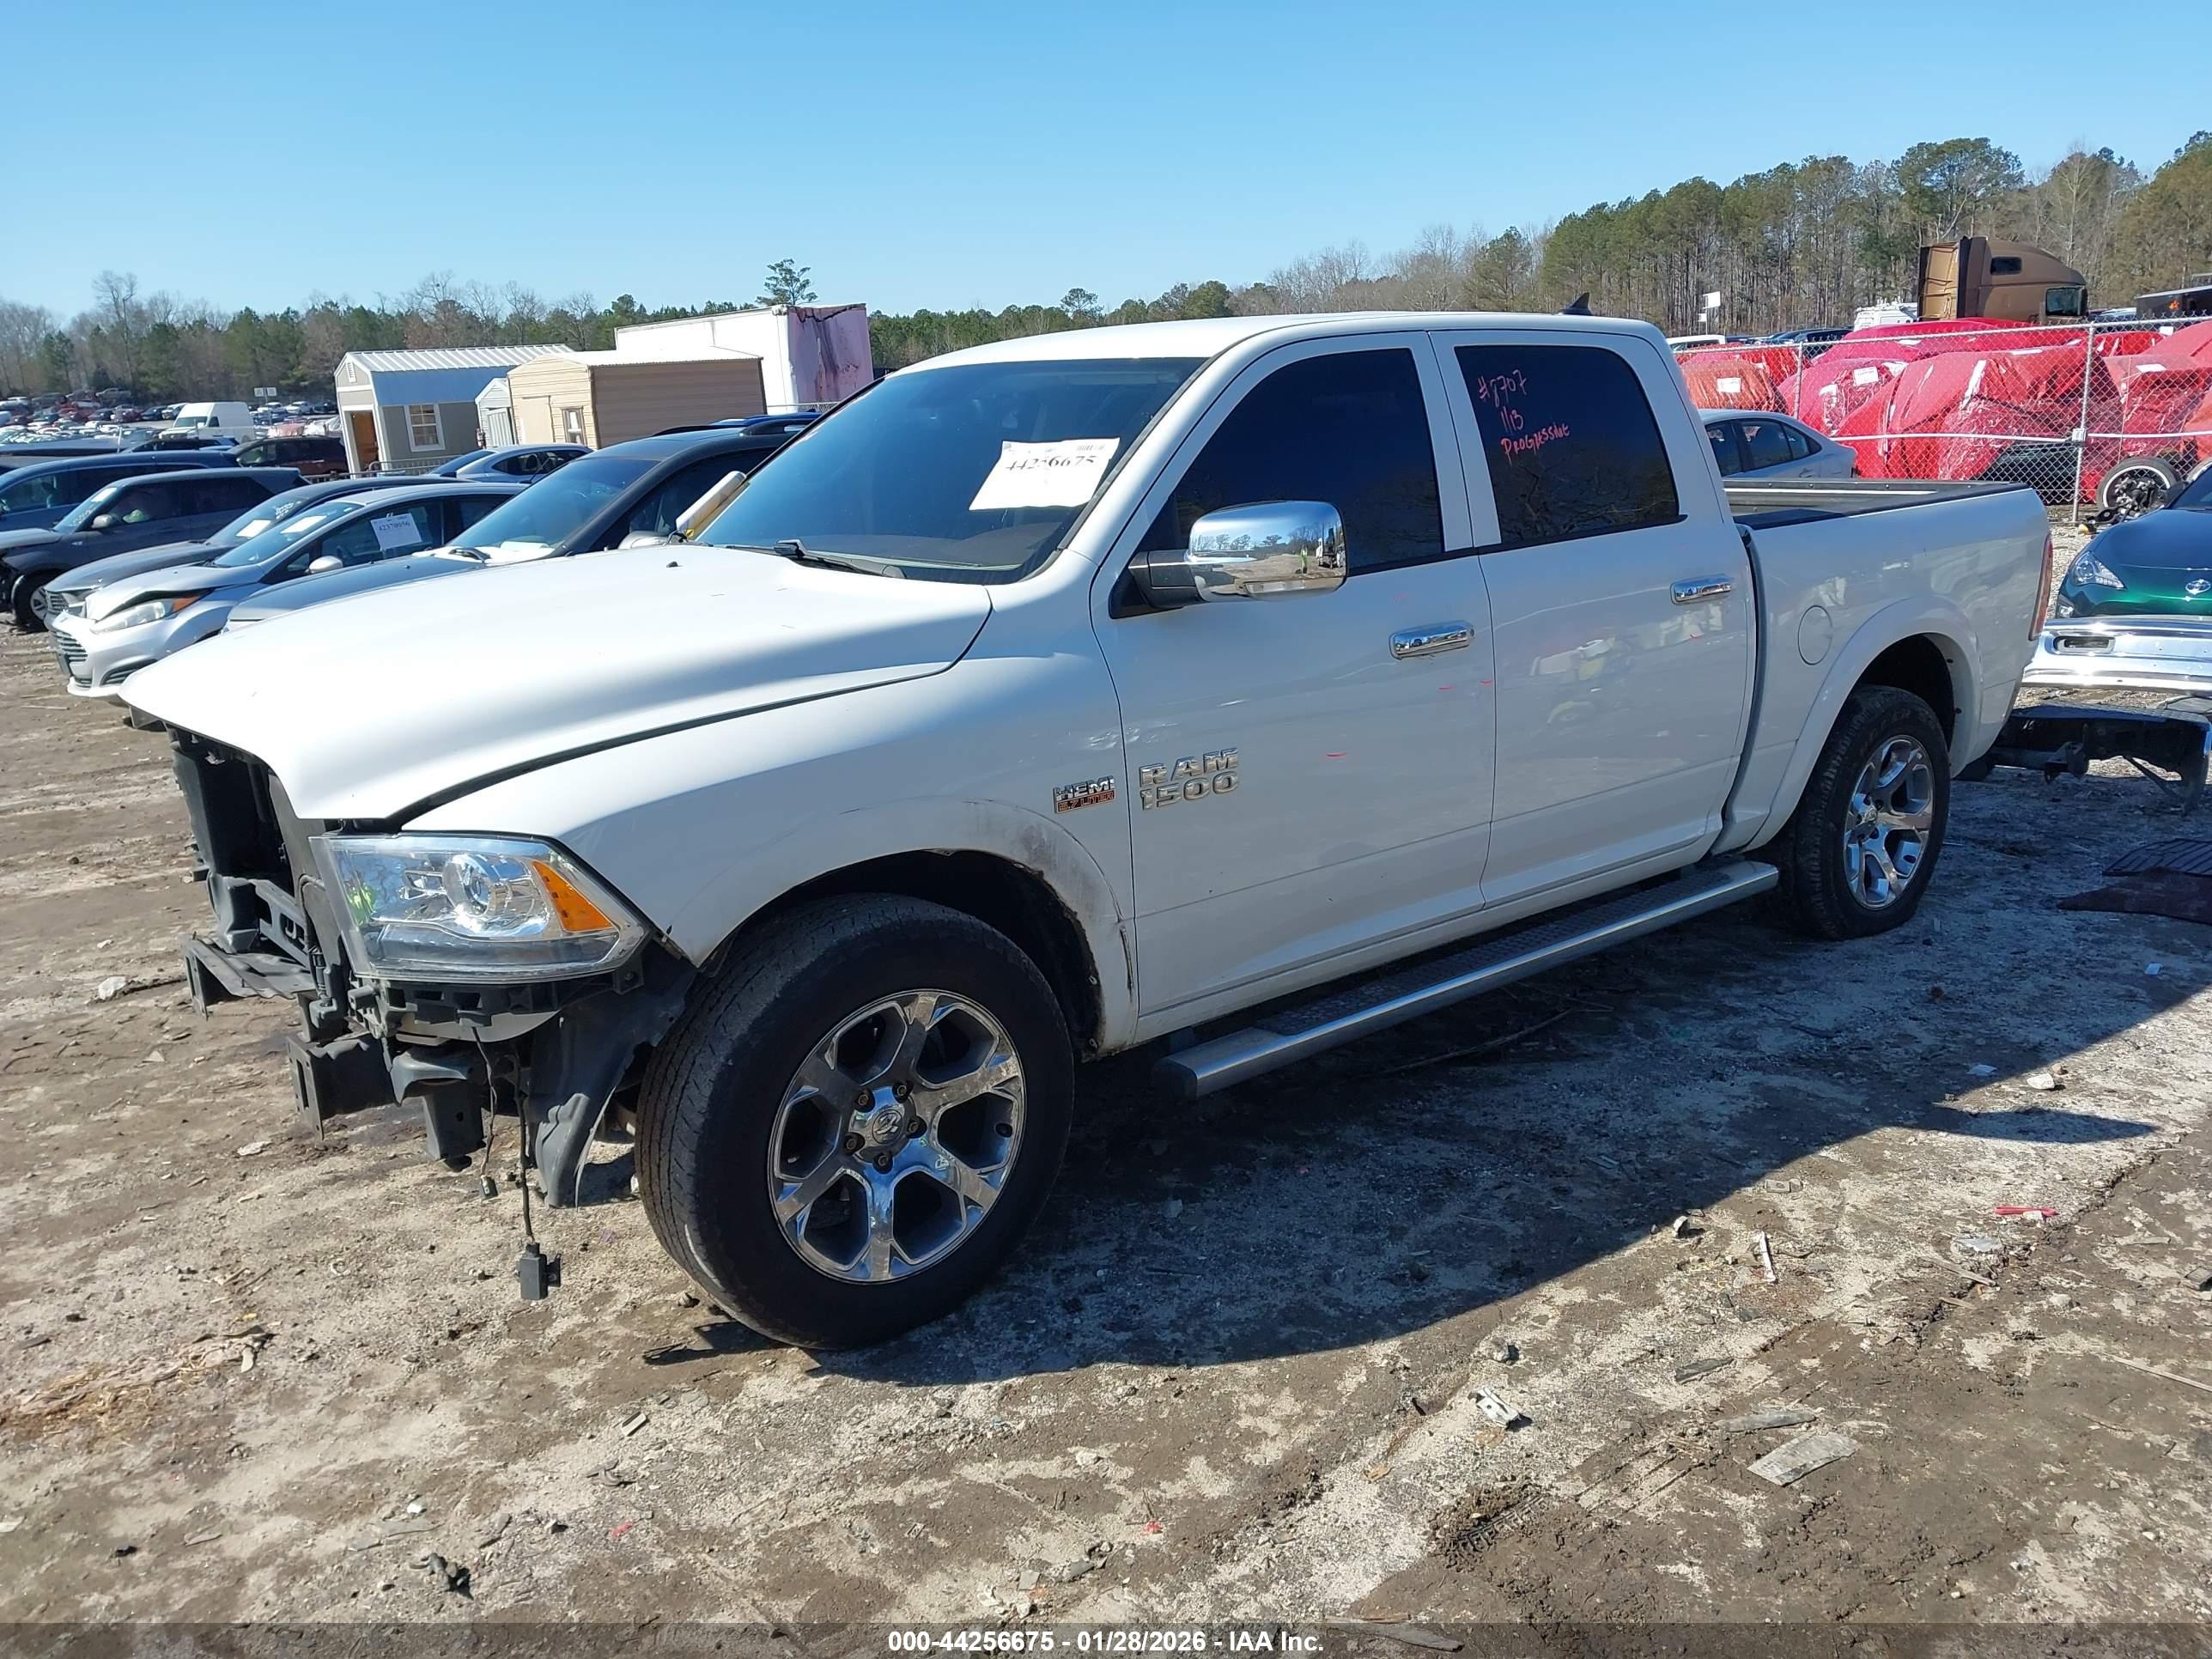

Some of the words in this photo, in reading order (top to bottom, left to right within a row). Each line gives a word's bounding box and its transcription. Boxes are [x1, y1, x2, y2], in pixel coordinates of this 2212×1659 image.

[1139, 747, 1237, 787] RAM
[1053, 775, 1116, 801] HEMI
[1057, 797, 1080, 812] 5.7
[1080, 791, 1115, 807] LITER
[1140, 771, 1239, 811] 1500
